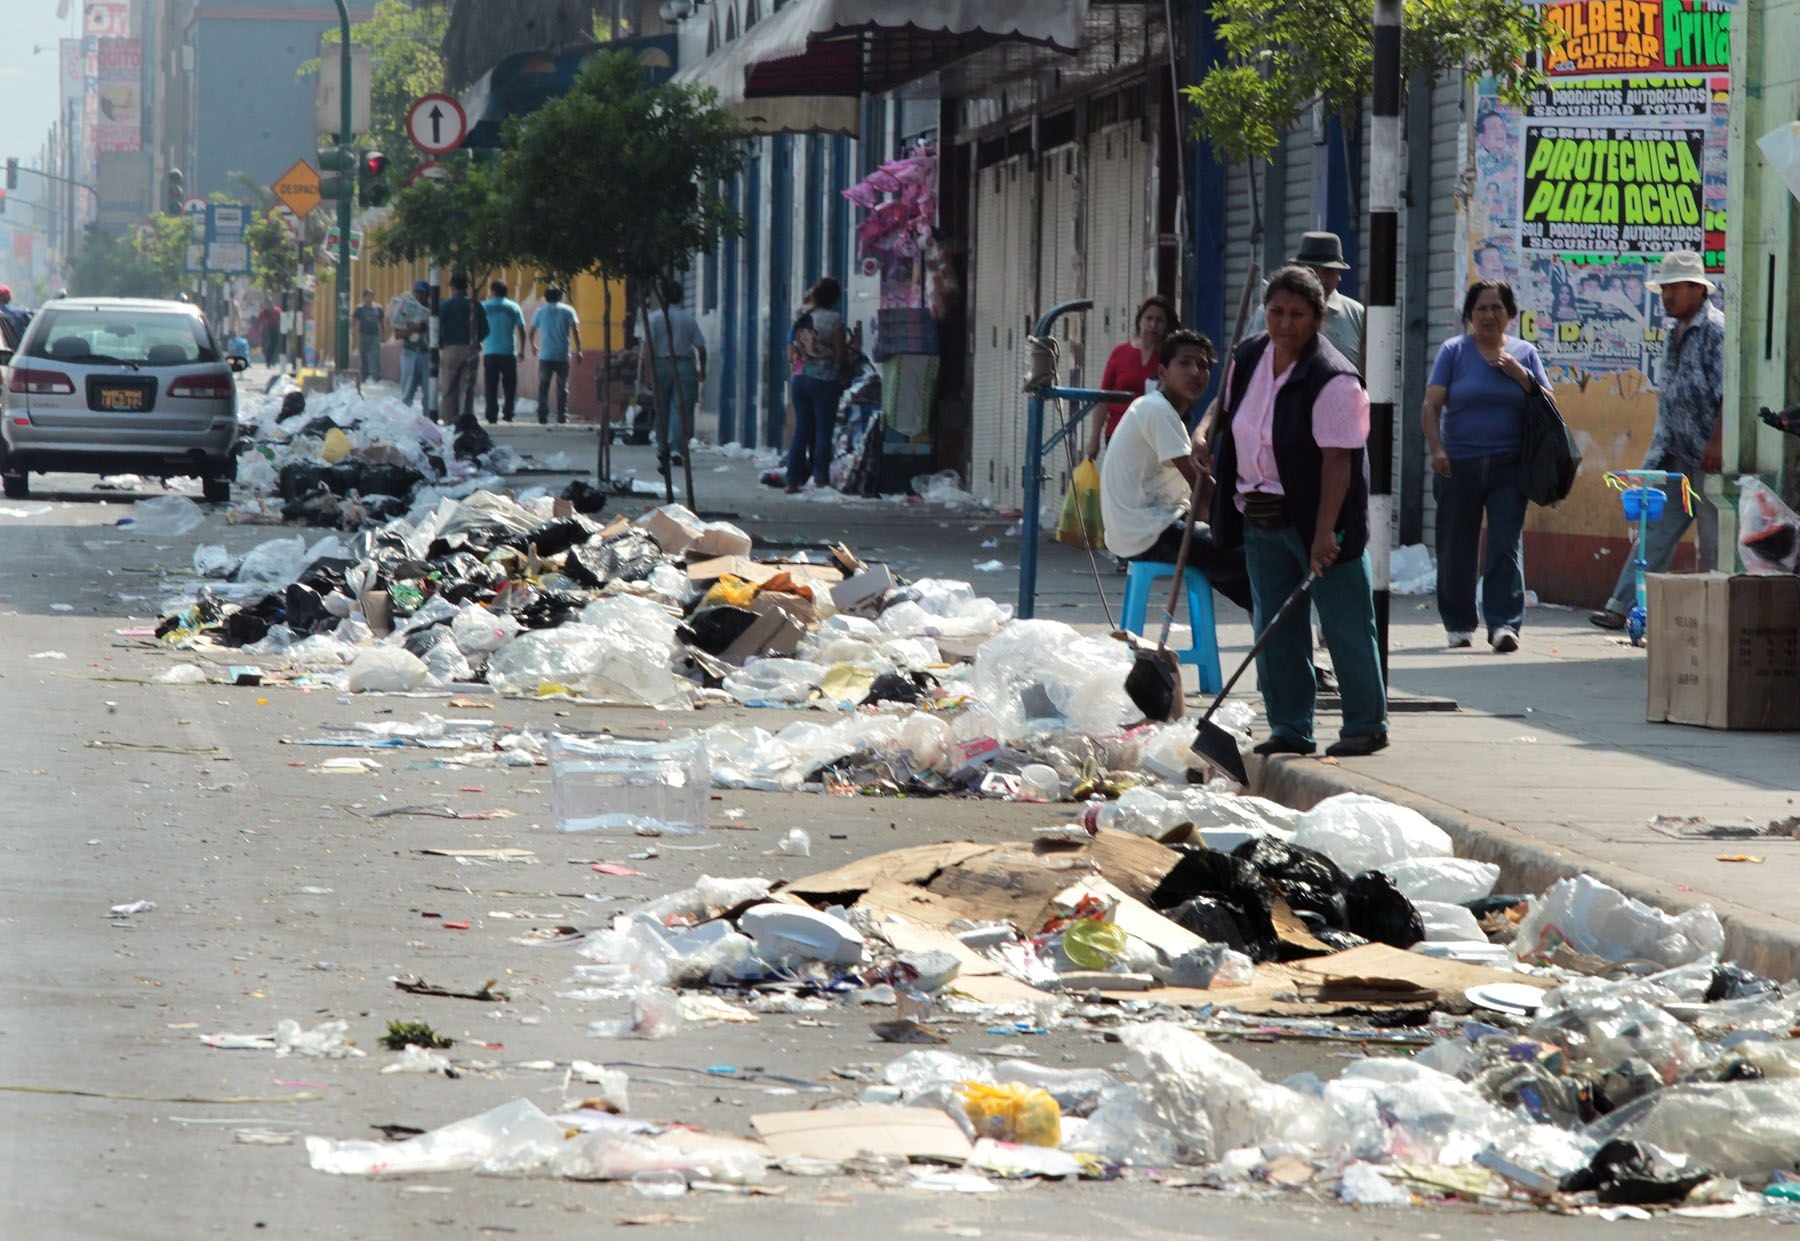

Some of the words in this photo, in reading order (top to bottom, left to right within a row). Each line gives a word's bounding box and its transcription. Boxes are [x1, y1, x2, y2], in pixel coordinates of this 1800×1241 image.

[1548, 31, 1660, 70] AGUILAR
[1594, 53, 1650, 68] TRIBU
[1553, 88, 1623, 106] PRODUCTOS
[1626, 87, 1706, 105] AUTORIZADOS
[1533, 104, 1634, 117] SEGURIDAD
[1642, 103, 1700, 115] TOTAL
[1541, 128, 1608, 140] GRAN
[1614, 129, 1688, 141] FERIA
[1526, 137, 1701, 184] PIROTECNICA
[1524, 180, 1620, 225] PLAZA
[1623, 183, 1700, 225] ACHO
[1550, 223, 1619, 241] PRODUCTOS
[1622, 224, 1703, 242] AUTORIZADOS
[1529, 237, 1630, 252] SEGURIDAD
[1637, 239, 1696, 252] TOTAL
